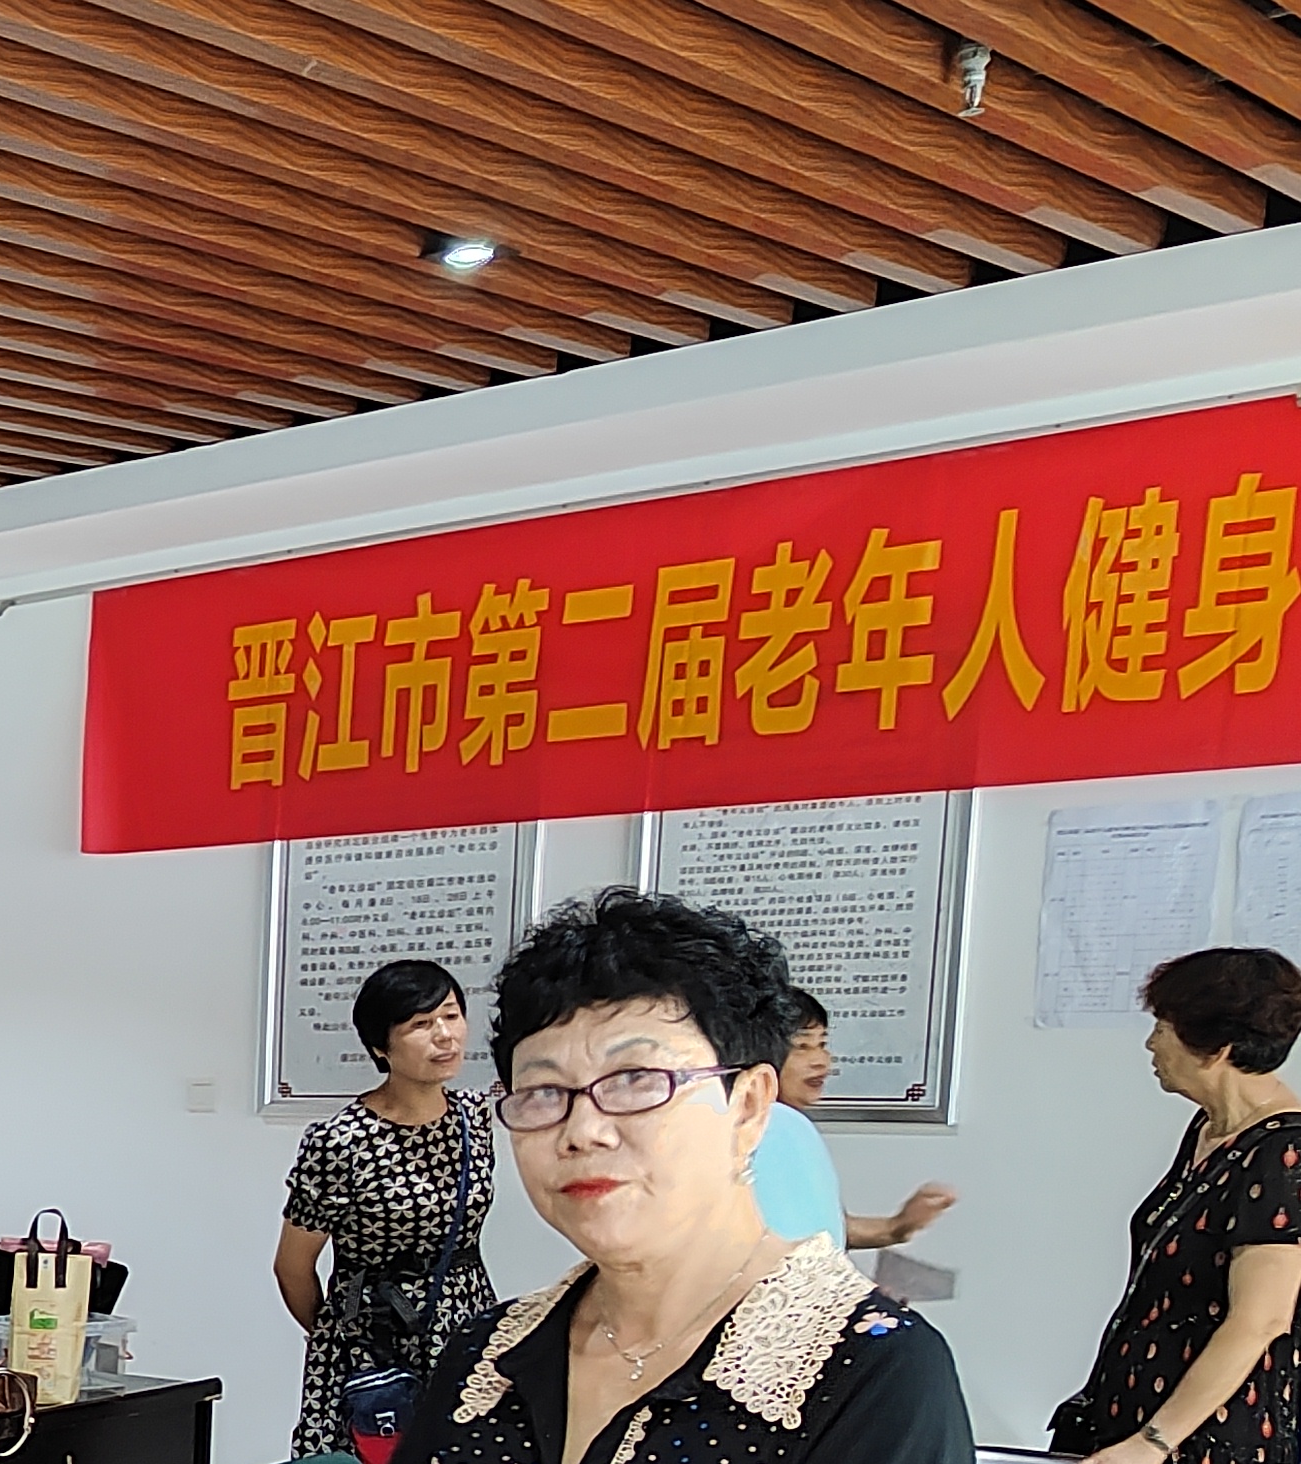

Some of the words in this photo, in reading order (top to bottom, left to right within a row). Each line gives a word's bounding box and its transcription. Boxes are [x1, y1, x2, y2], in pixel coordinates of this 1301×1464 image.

[228, 472, 1301, 790] 晋江市第二届老年人健身
